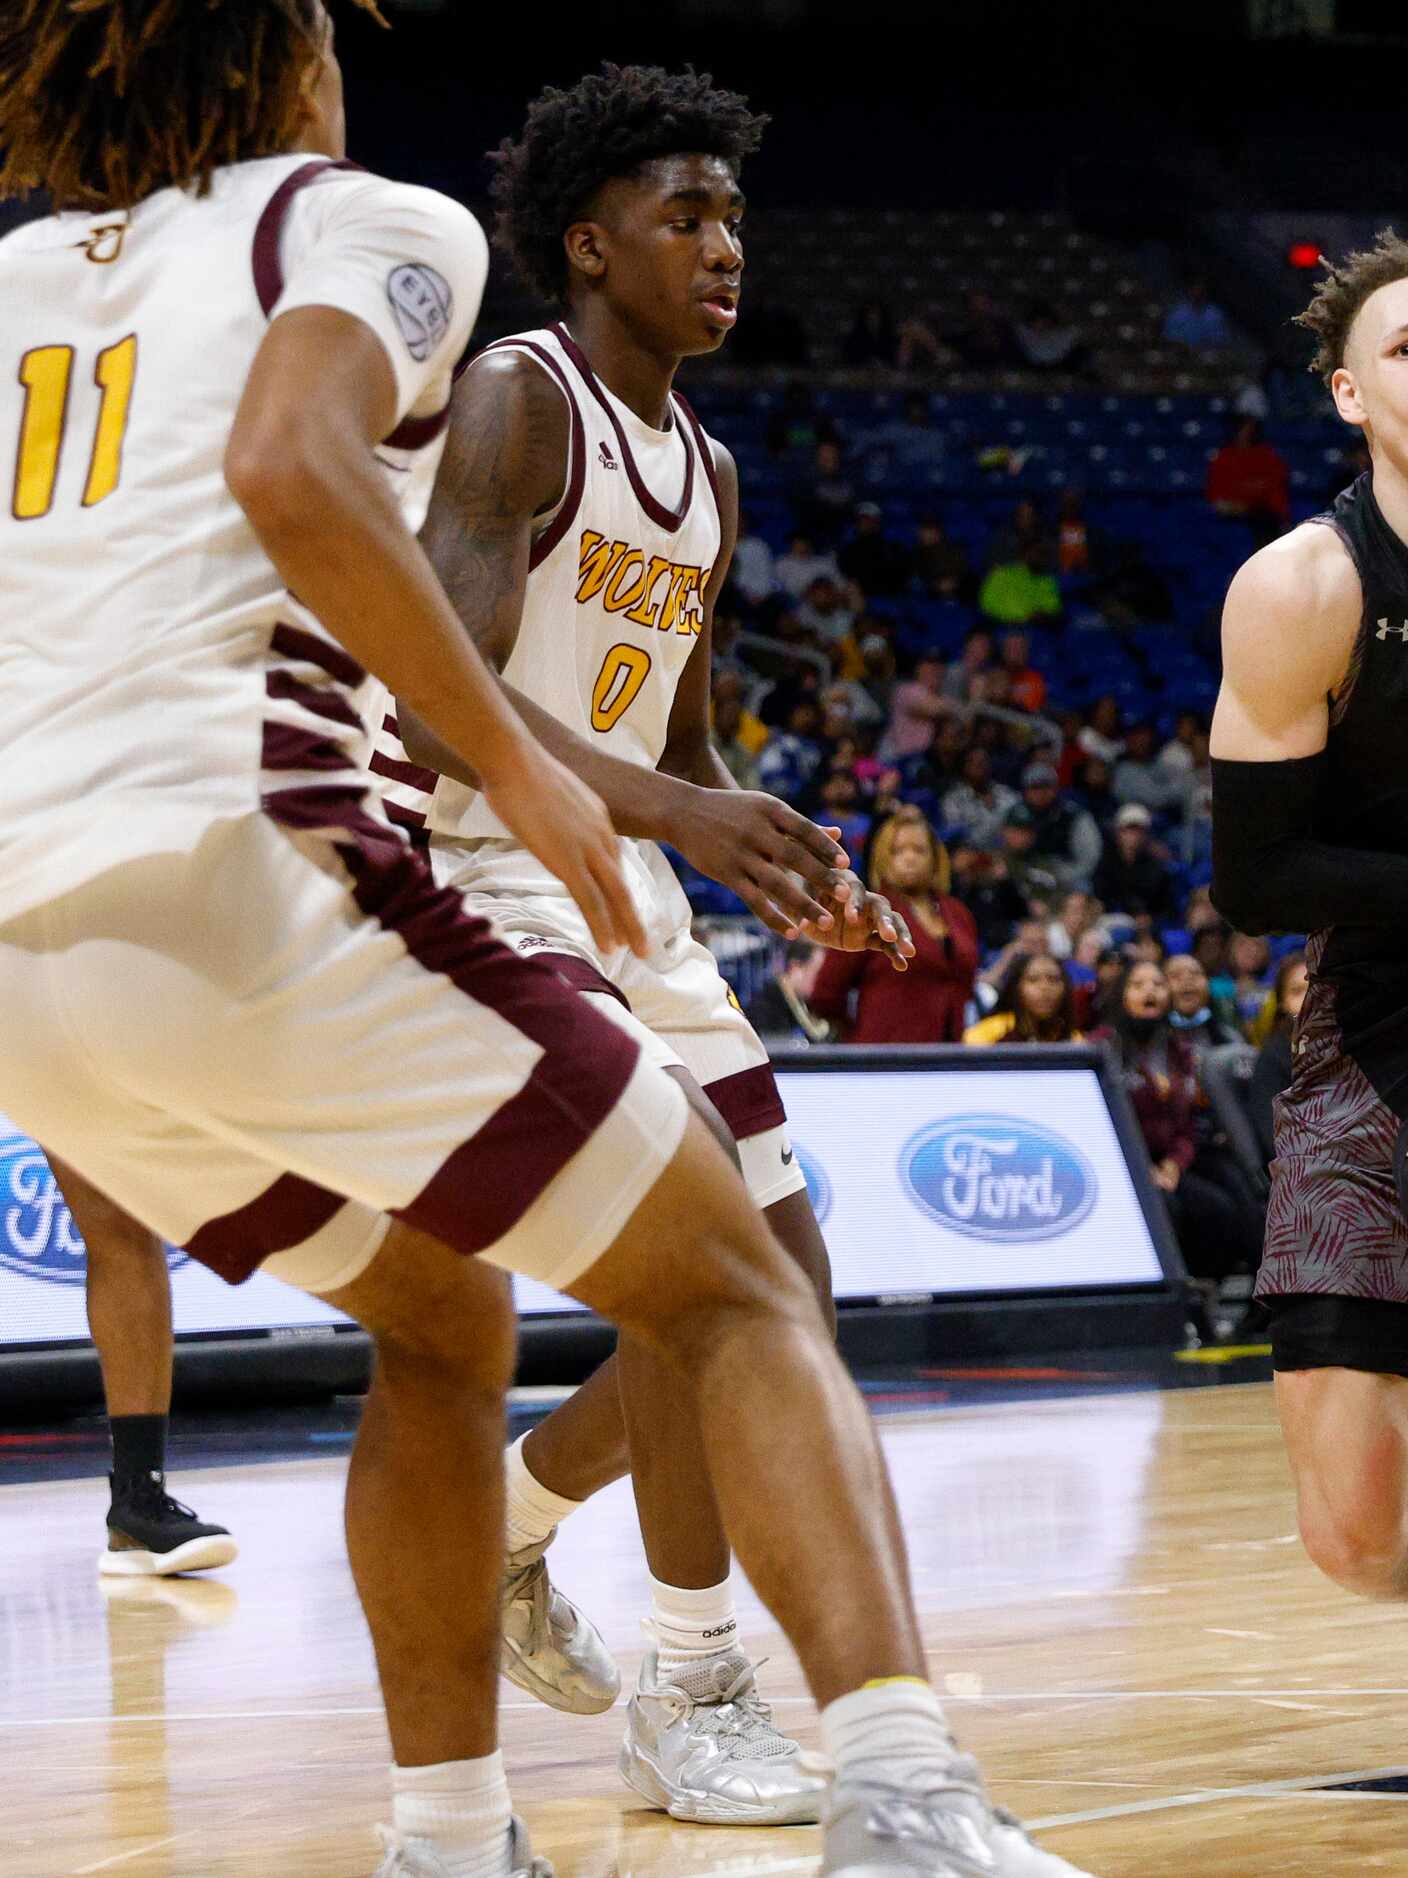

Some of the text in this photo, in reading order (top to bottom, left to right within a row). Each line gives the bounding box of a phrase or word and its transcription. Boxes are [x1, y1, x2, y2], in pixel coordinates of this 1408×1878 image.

[12, 332, 137, 520] 11
[591, 643, 651, 732] 0
[943, 1133, 1063, 1218] Ford
